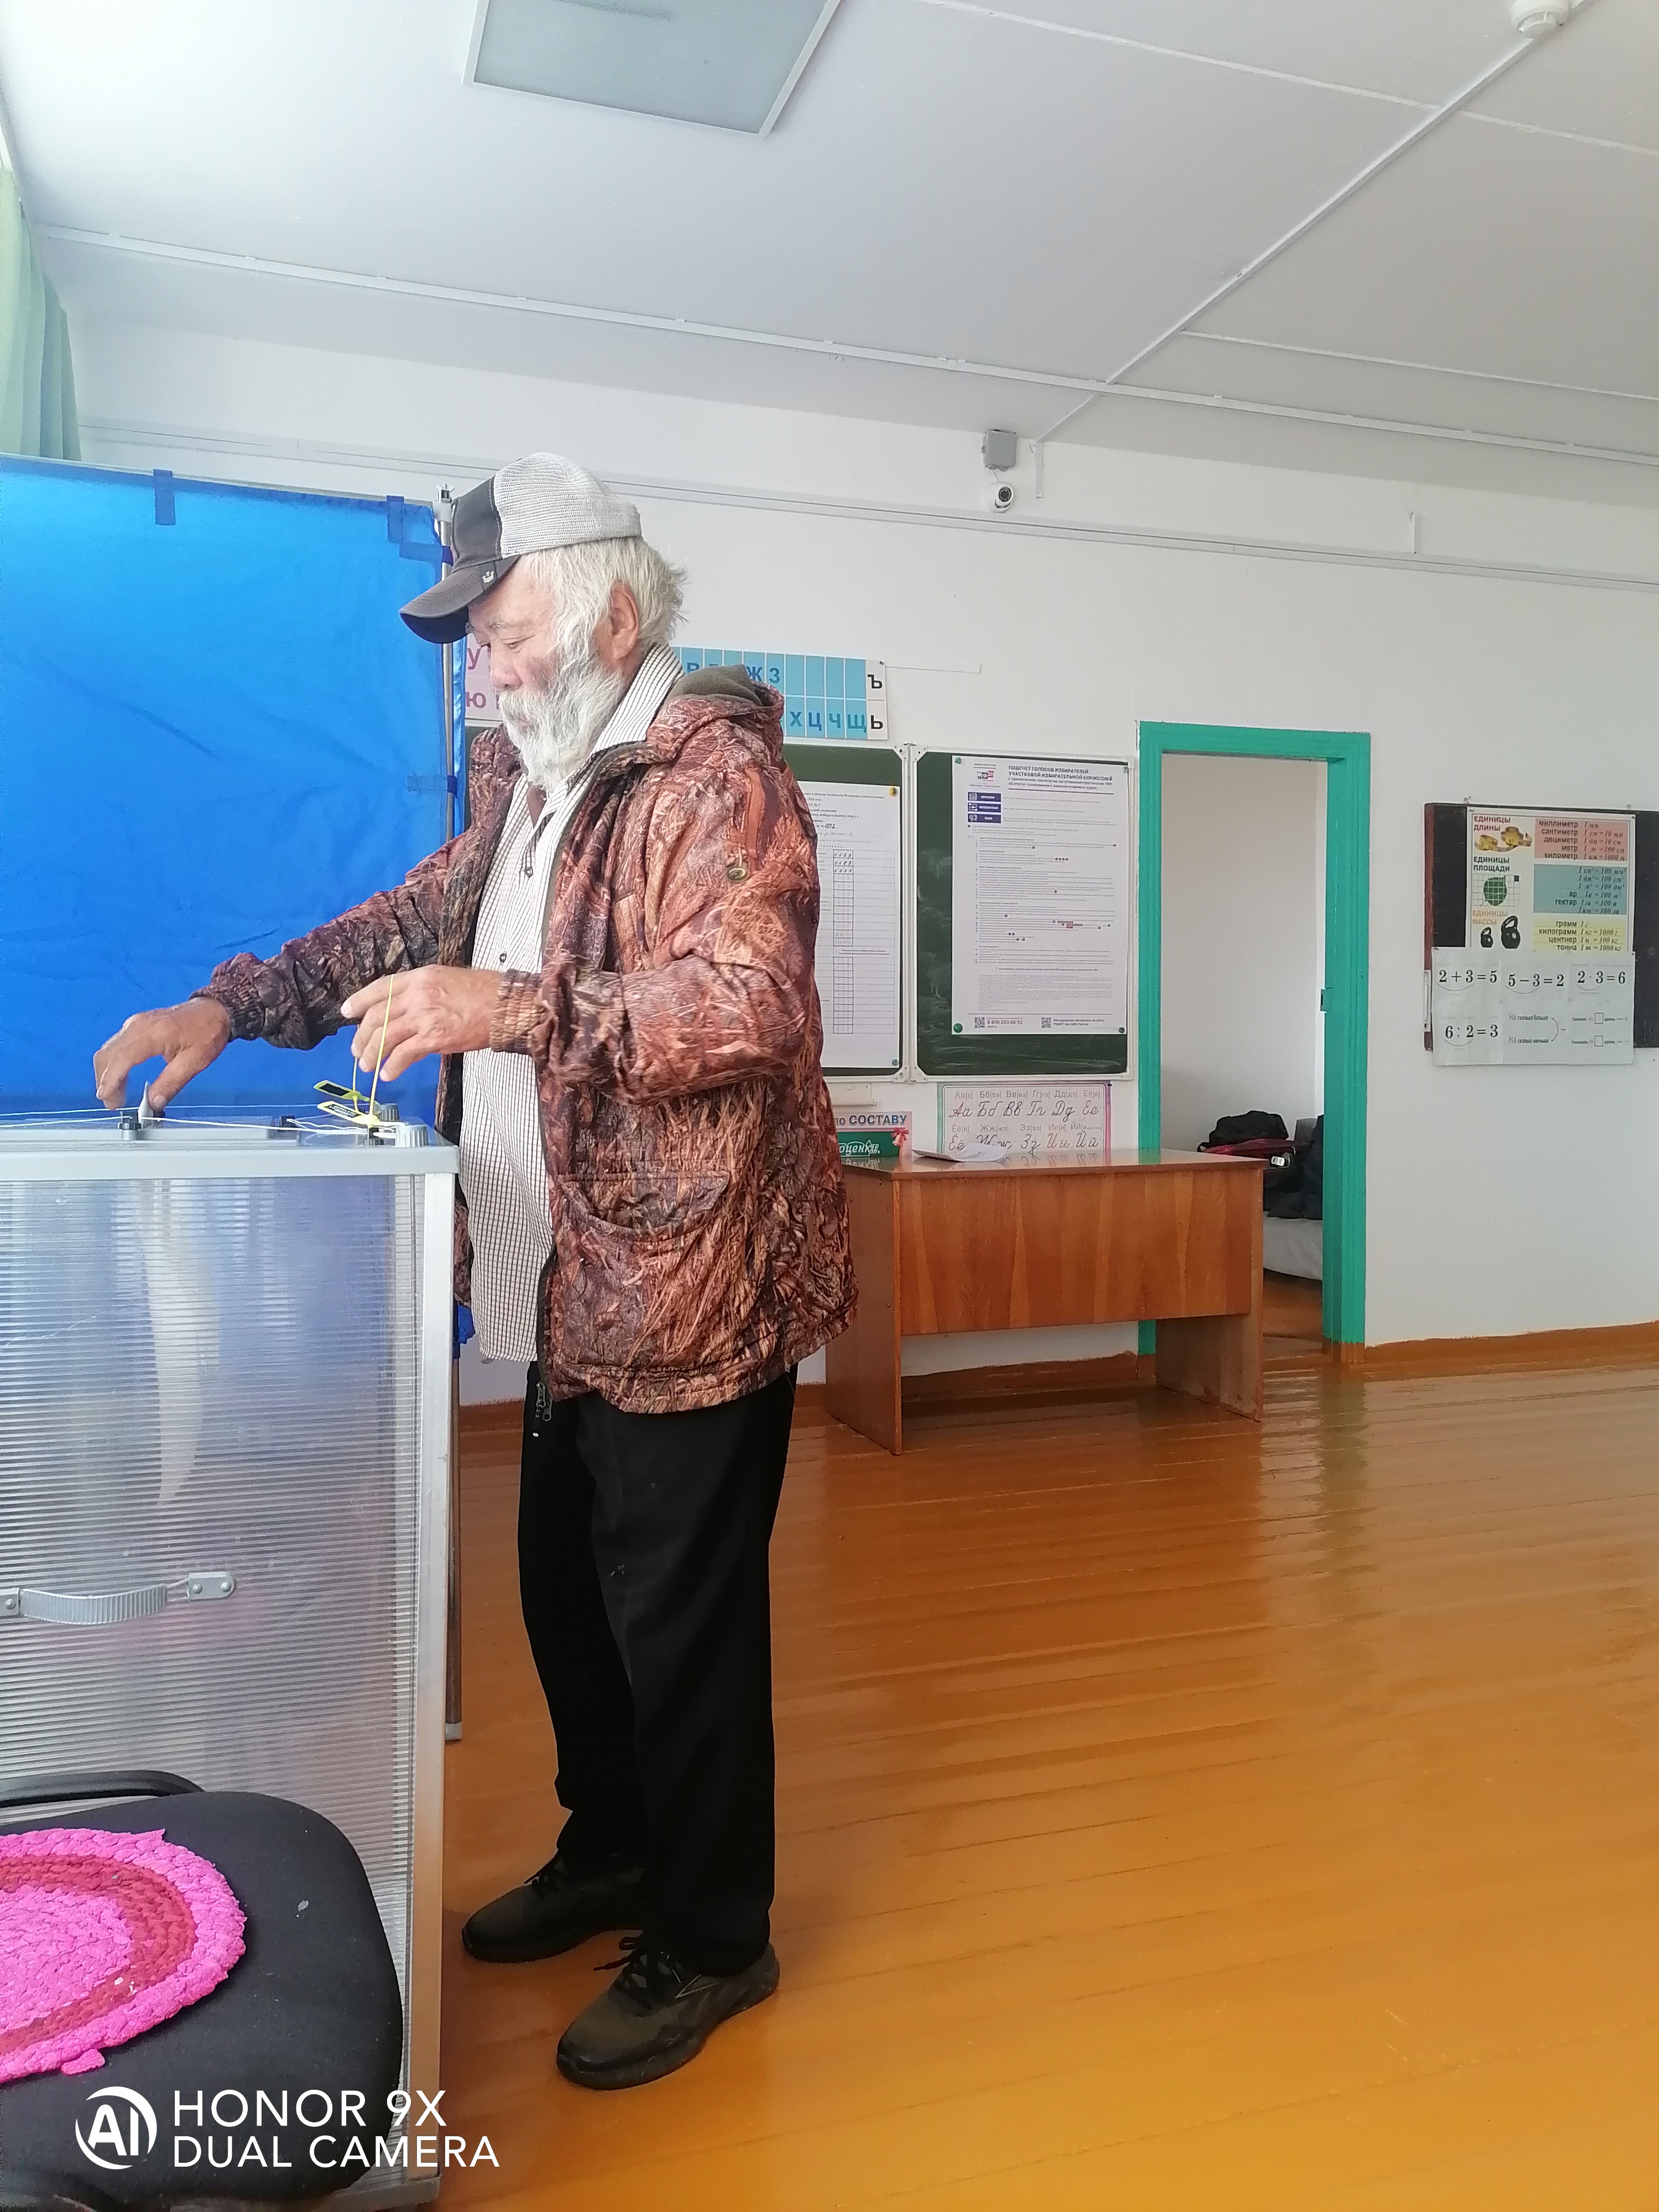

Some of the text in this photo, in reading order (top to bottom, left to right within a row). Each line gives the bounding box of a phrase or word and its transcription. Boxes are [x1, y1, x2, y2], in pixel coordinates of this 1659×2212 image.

[868, 675, 883, 689] Ъ
[790, 711, 883, 733] Х Ц Ч Щ Ь
[1539, 821, 1578, 830] миллиметр
[1541, 828, 1578, 837] сантиметр
[1543, 837, 1578, 845] дециметр
[1562, 845, 1578, 853] метр
[1545, 853, 1578, 861] километр
[849, 1114, 907, 1126] СОСТАВУ
